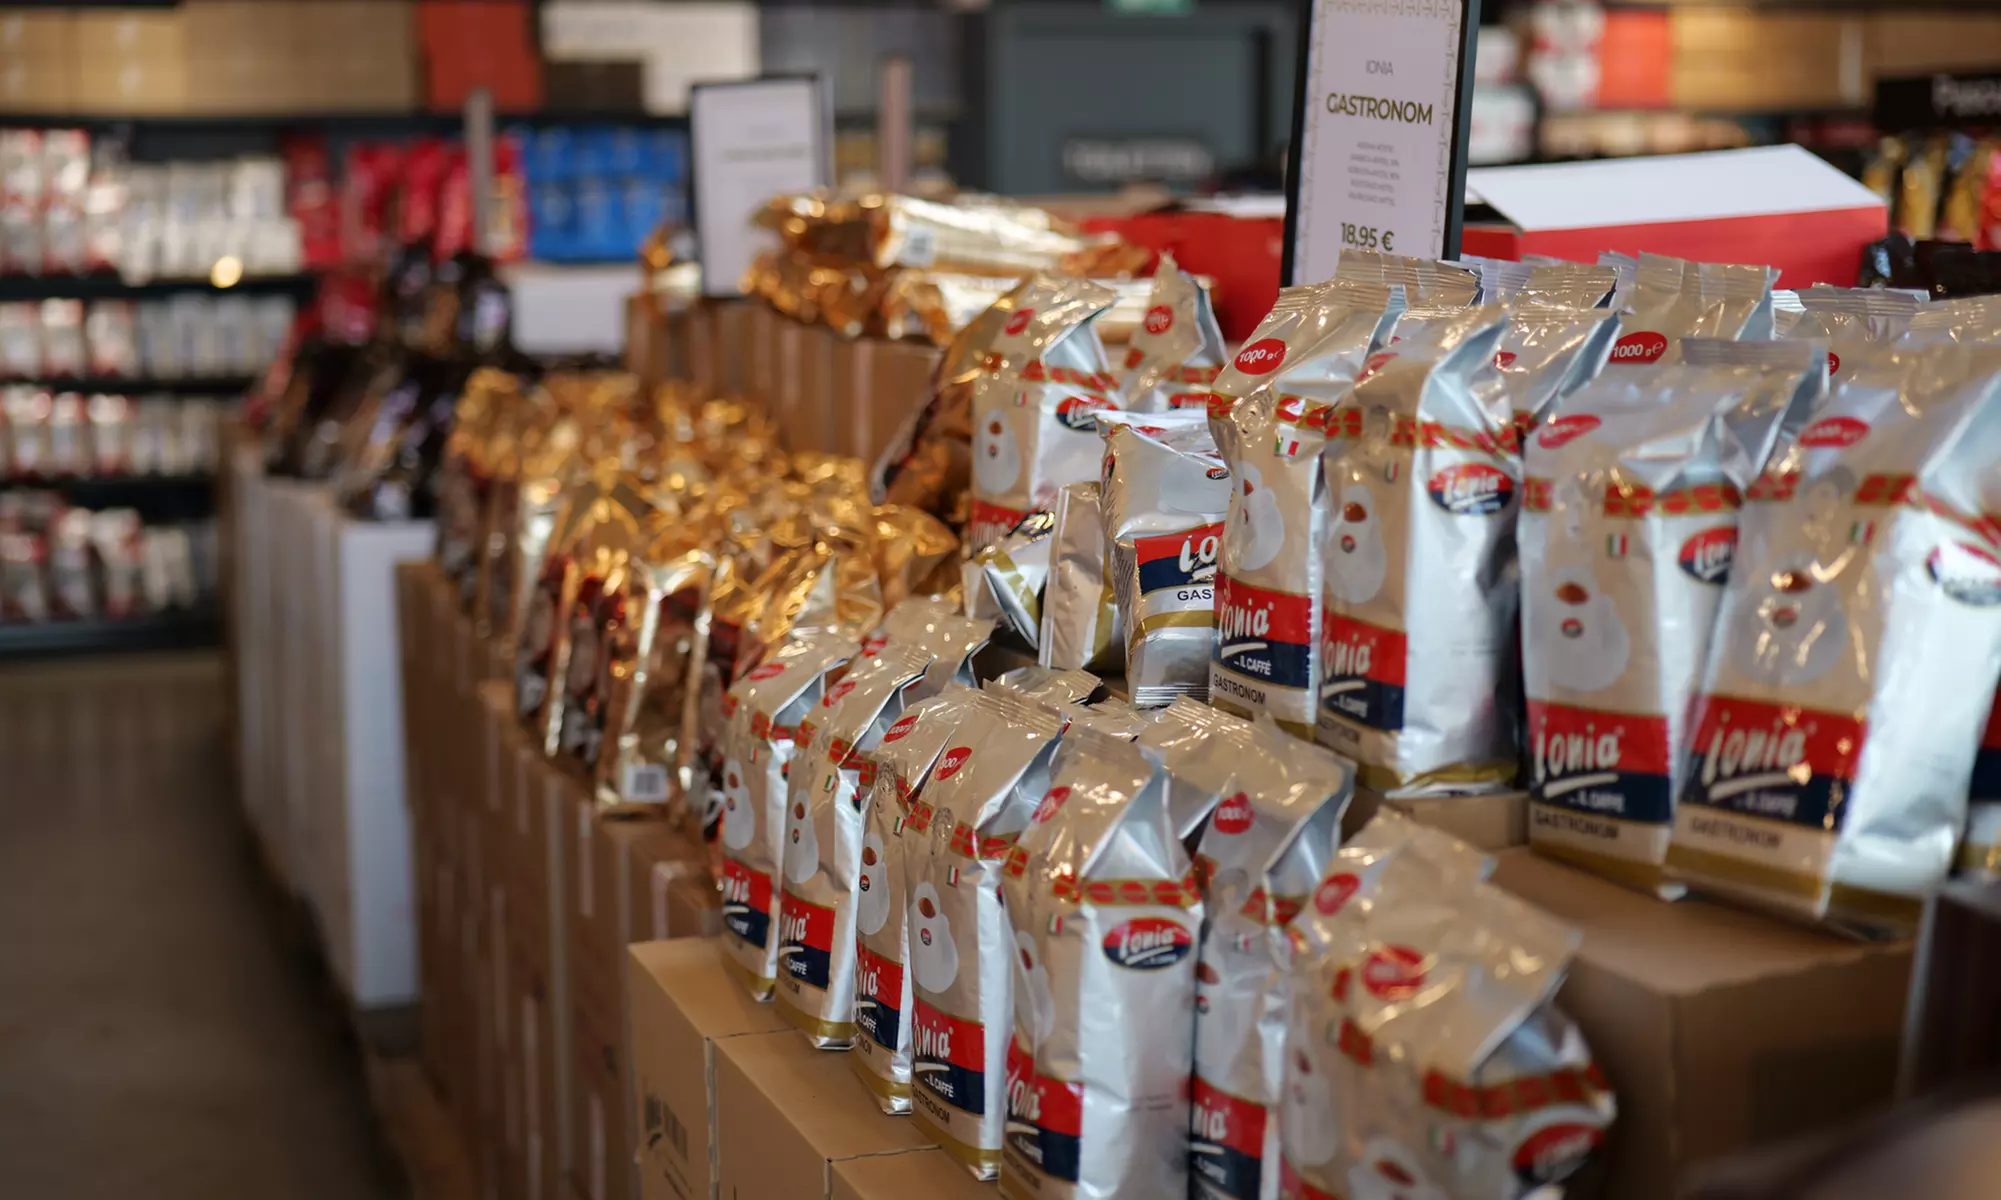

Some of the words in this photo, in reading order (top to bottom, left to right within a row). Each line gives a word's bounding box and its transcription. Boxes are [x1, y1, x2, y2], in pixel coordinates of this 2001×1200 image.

[1365, 60, 1394, 76] IONIA
[1326, 92, 1433, 126] GASTRONOM
[1341, 222, 1377, 248] 18,95
[1382, 230, 1395, 251] €
[1240, 349, 1267, 362] 1000
[1612, 343, 1644, 358] 1000
[1213, 673, 1266, 706] GASTRONOM
